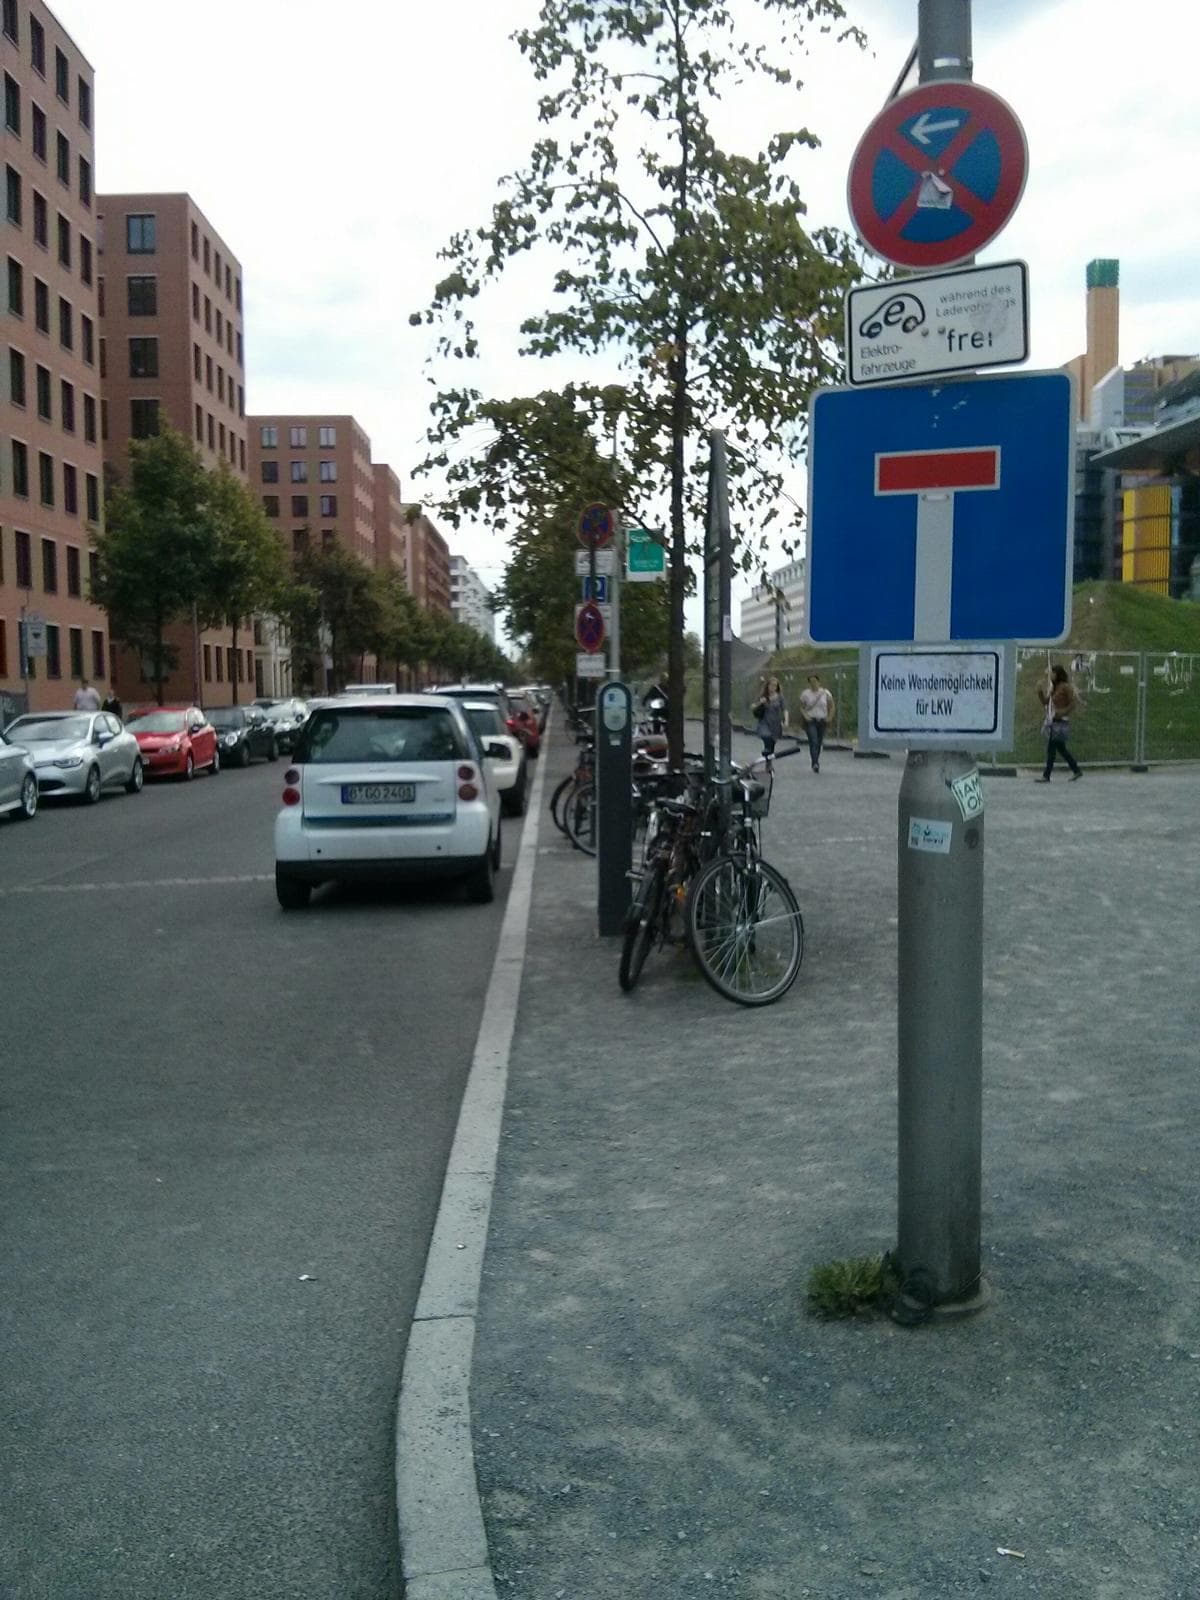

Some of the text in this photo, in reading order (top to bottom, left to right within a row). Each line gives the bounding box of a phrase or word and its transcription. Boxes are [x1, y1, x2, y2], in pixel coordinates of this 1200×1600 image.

[939, 284, 1012, 303] während des
[946, 328, 993, 352] frei
[860, 342, 903, 359] Elektro-
[880, 672, 993, 694] Keine Wendemöglichkeit
[916, 698, 954, 715] für LKW
